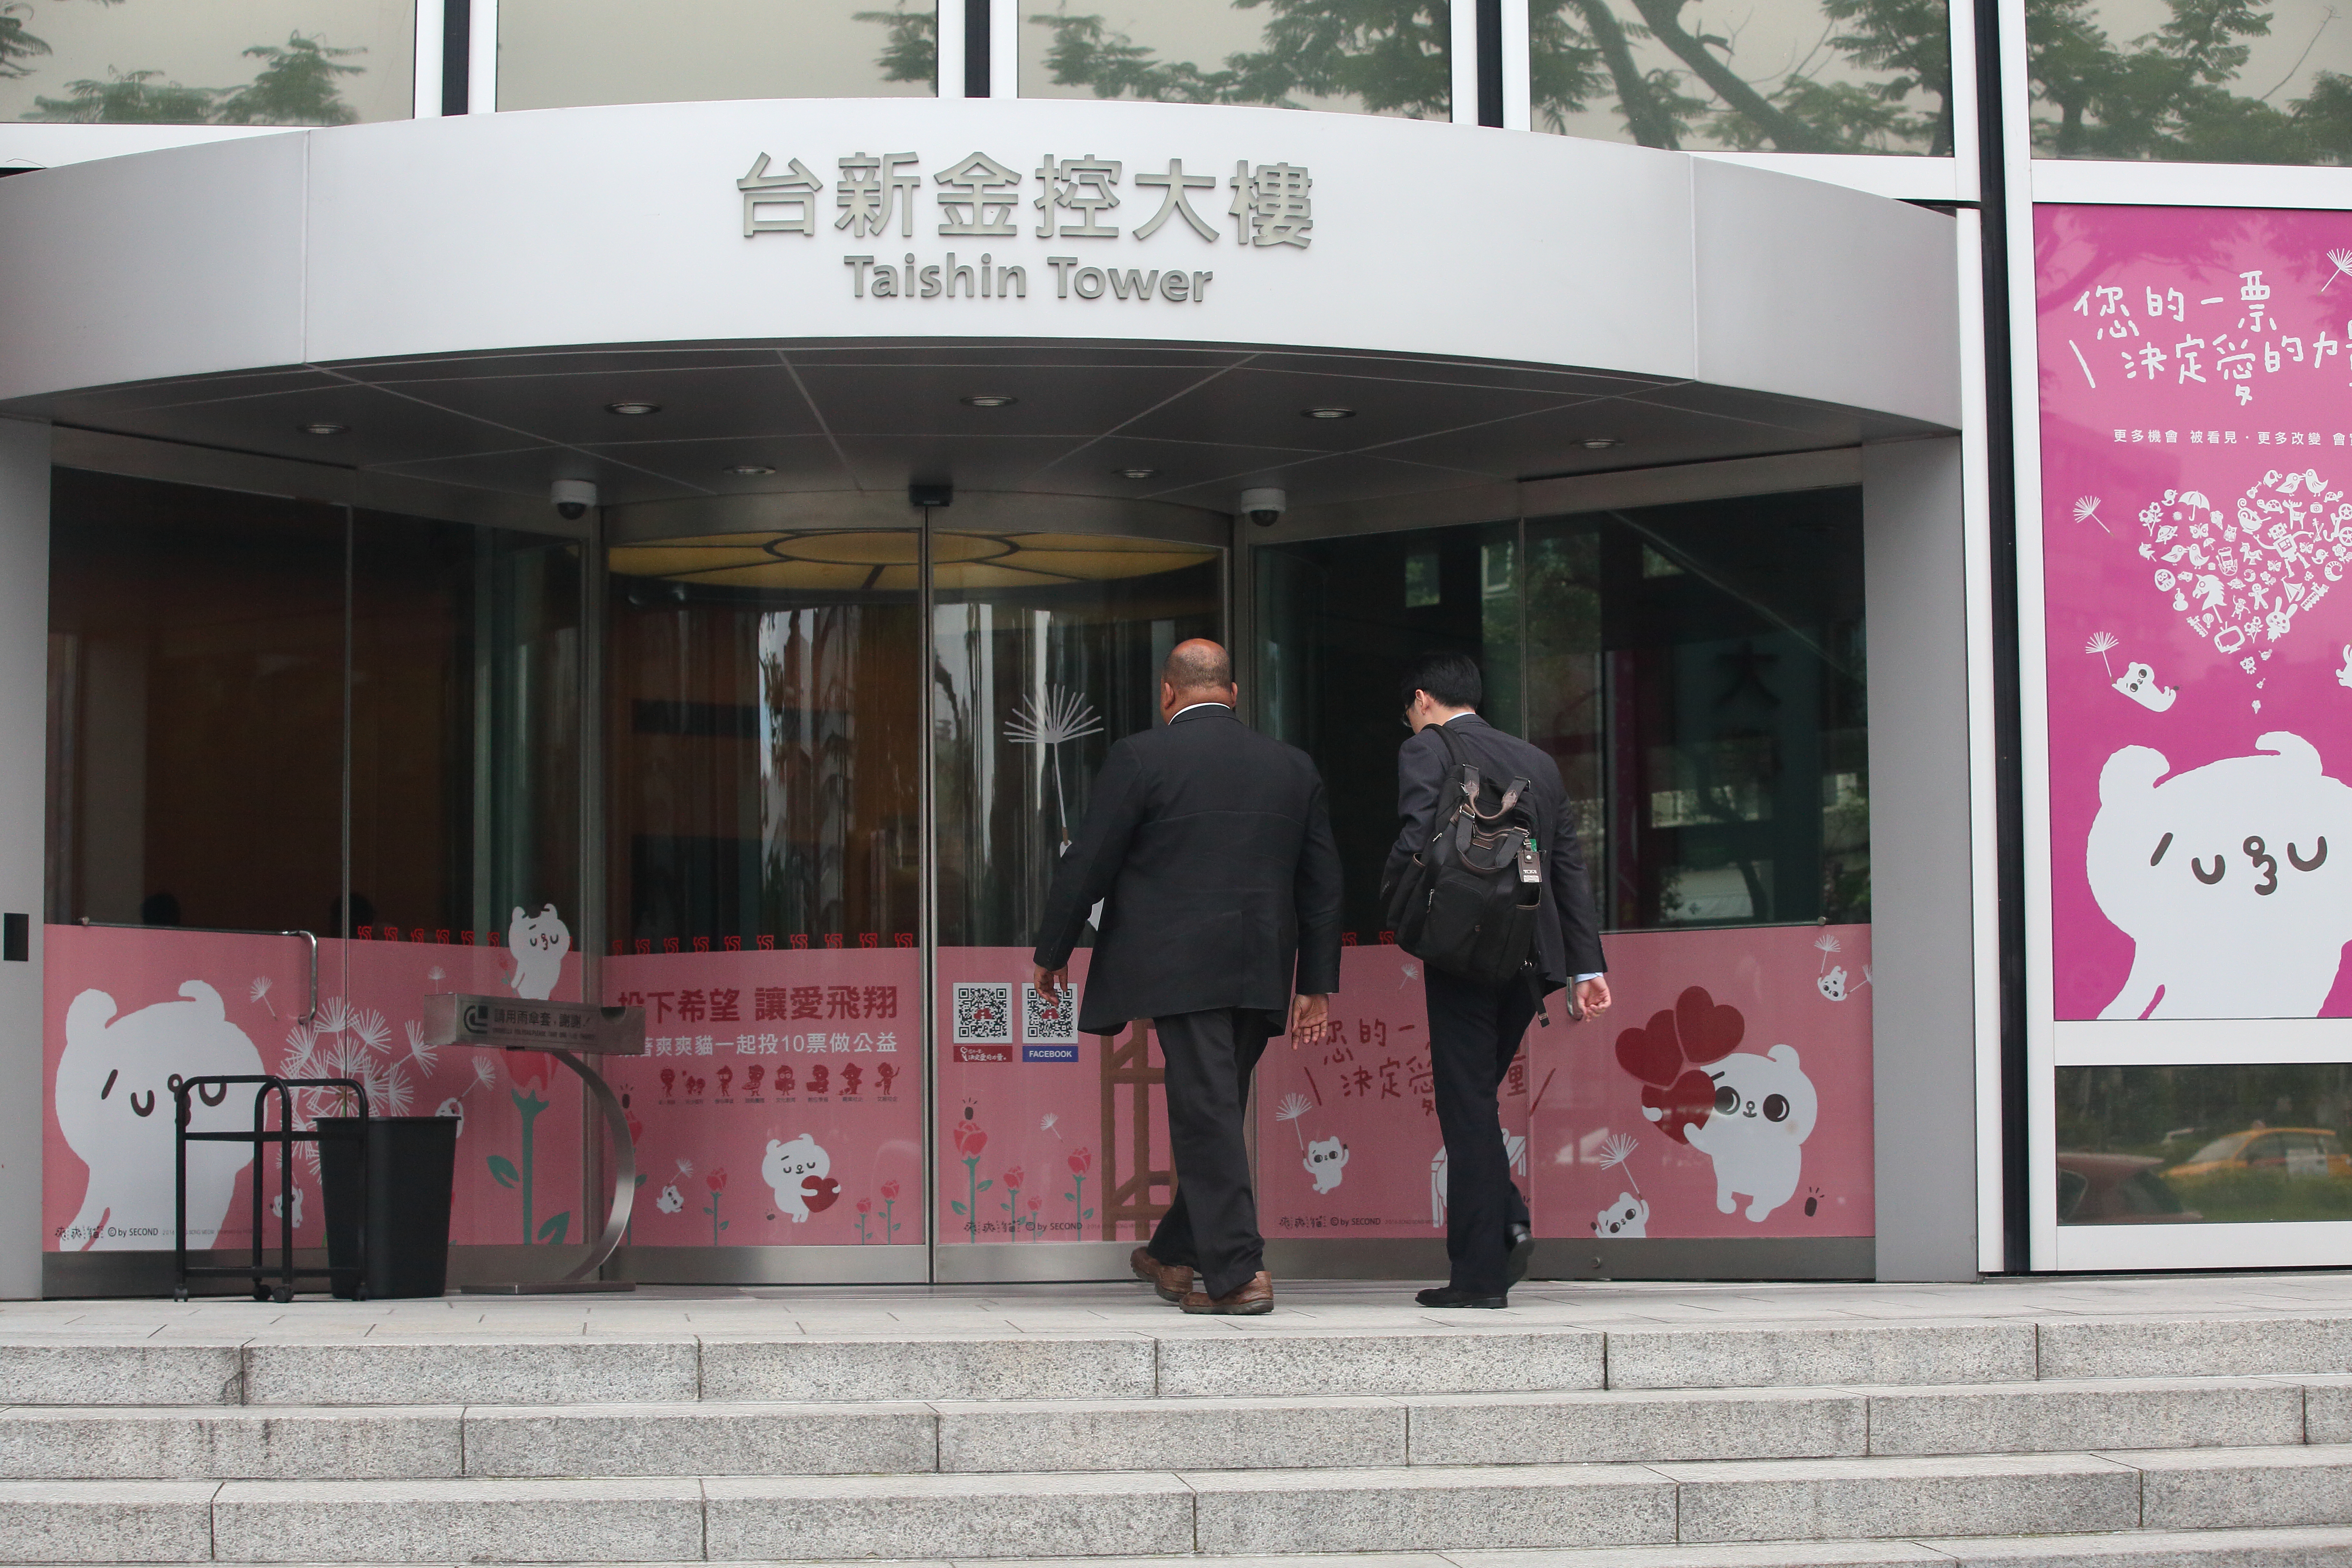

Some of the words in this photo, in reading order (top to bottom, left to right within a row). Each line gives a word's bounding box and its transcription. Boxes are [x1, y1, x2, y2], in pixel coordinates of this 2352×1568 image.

[736, 151, 1314, 248] 台新金控大樓
[844, 252, 1026, 298] Taishin
[1047, 255, 1214, 302] Tower
[2074, 270, 2277, 340] 您的一票
[2121, 320, 2352, 405] 決定愛的力
[2114, 429, 2178, 443] 更多機會
[2333, 432, 2352, 446] 會
[755, 985, 897, 1021] 讓愛飛翔
[618, 1032, 897, 1057] 爽爽貓一起投10票做公益
[129, 1227, 158, 1236] SECOND
